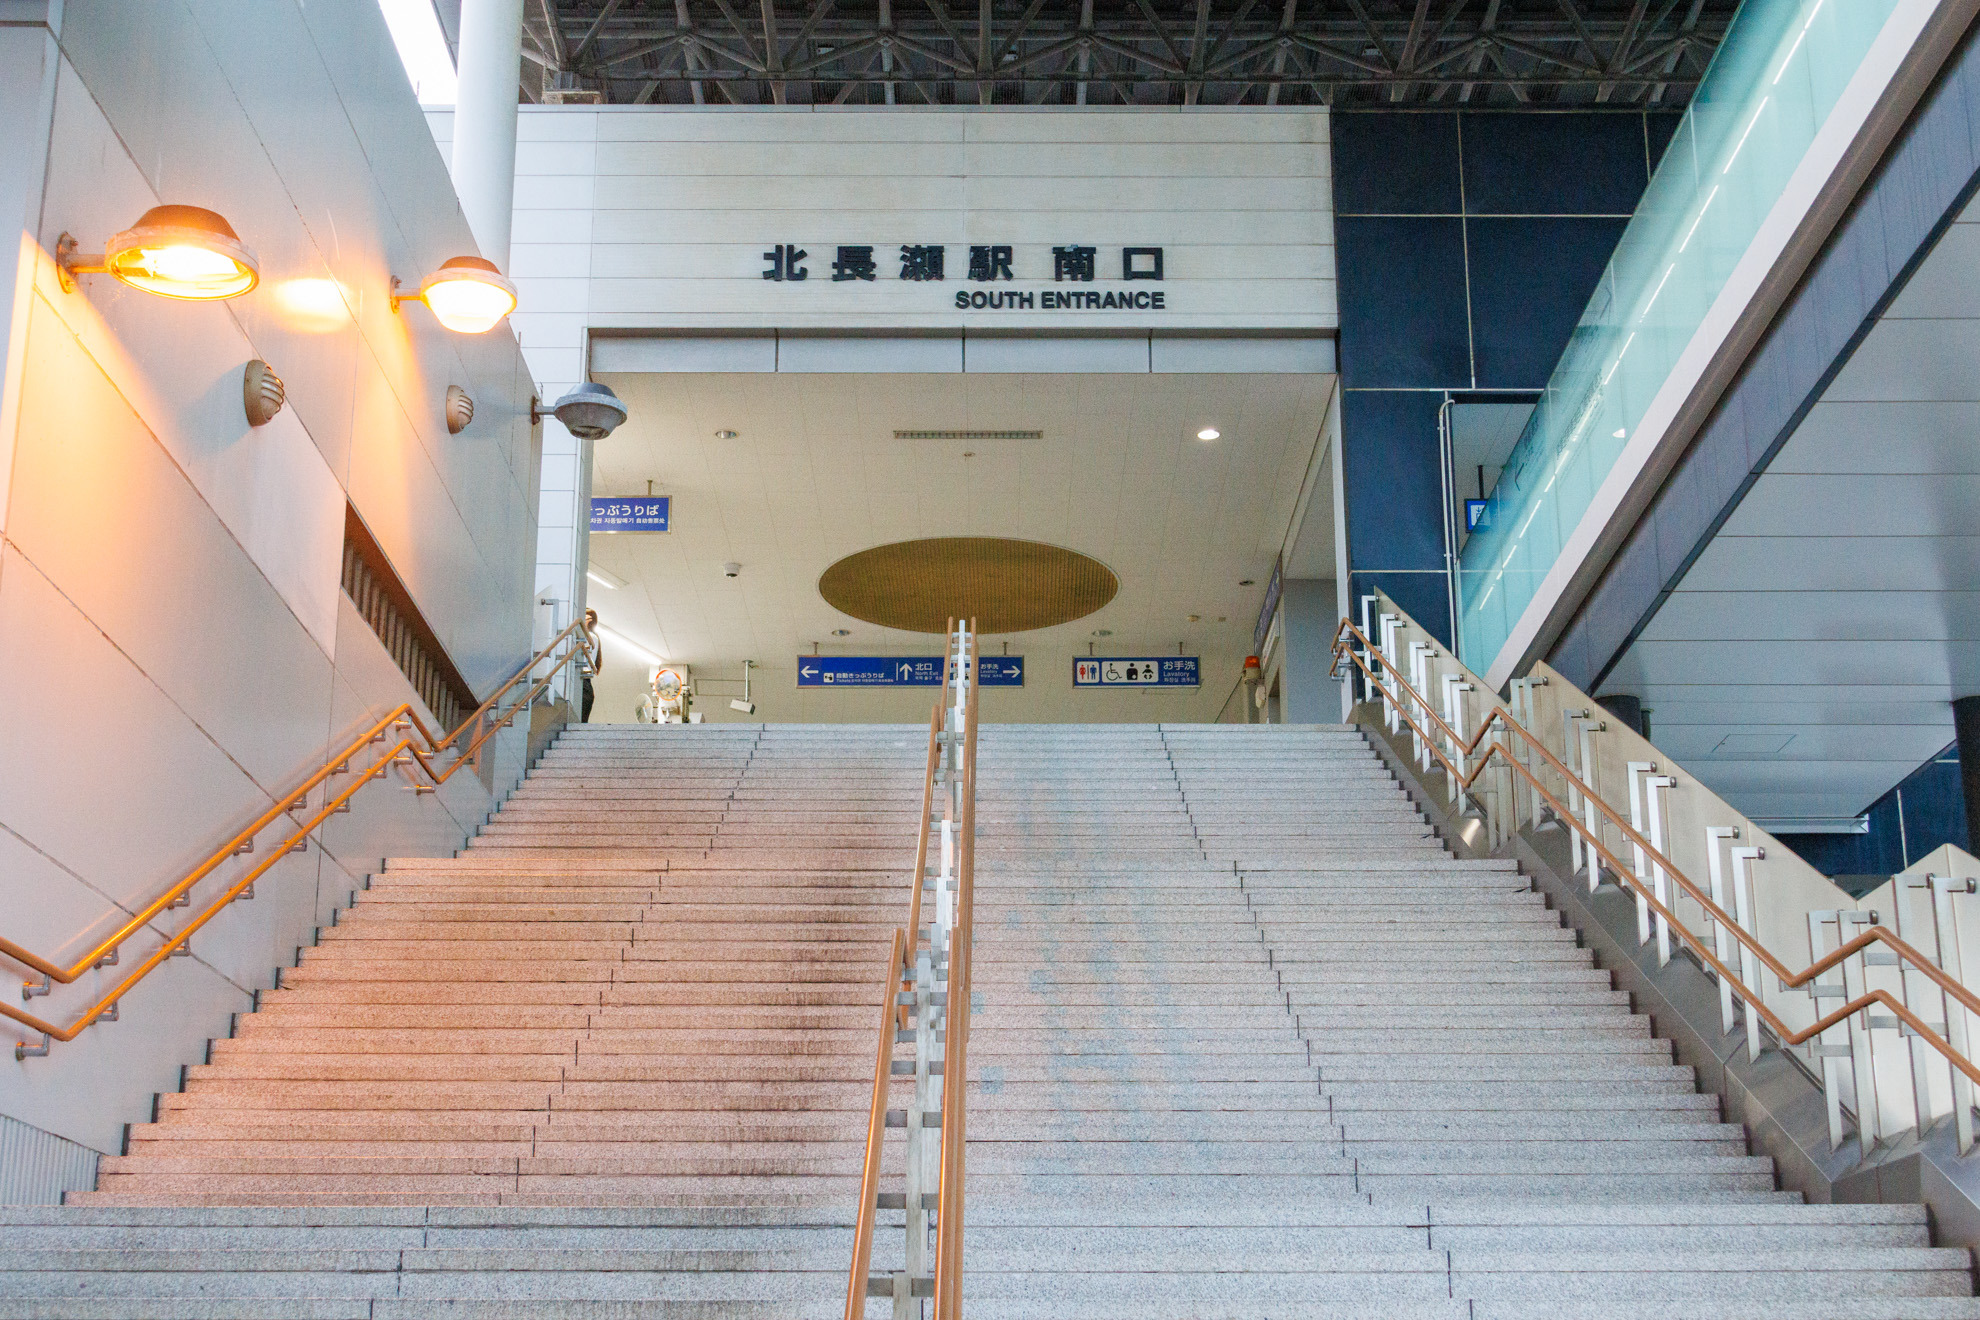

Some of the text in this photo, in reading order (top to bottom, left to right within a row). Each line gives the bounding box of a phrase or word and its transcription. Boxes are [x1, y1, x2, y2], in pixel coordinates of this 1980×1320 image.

[954, 291, 1165, 309] SOUTH ENTRANCE
[590, 505, 659, 516] っぷうりば
[1164, 660, 1196, 670] お手洗
